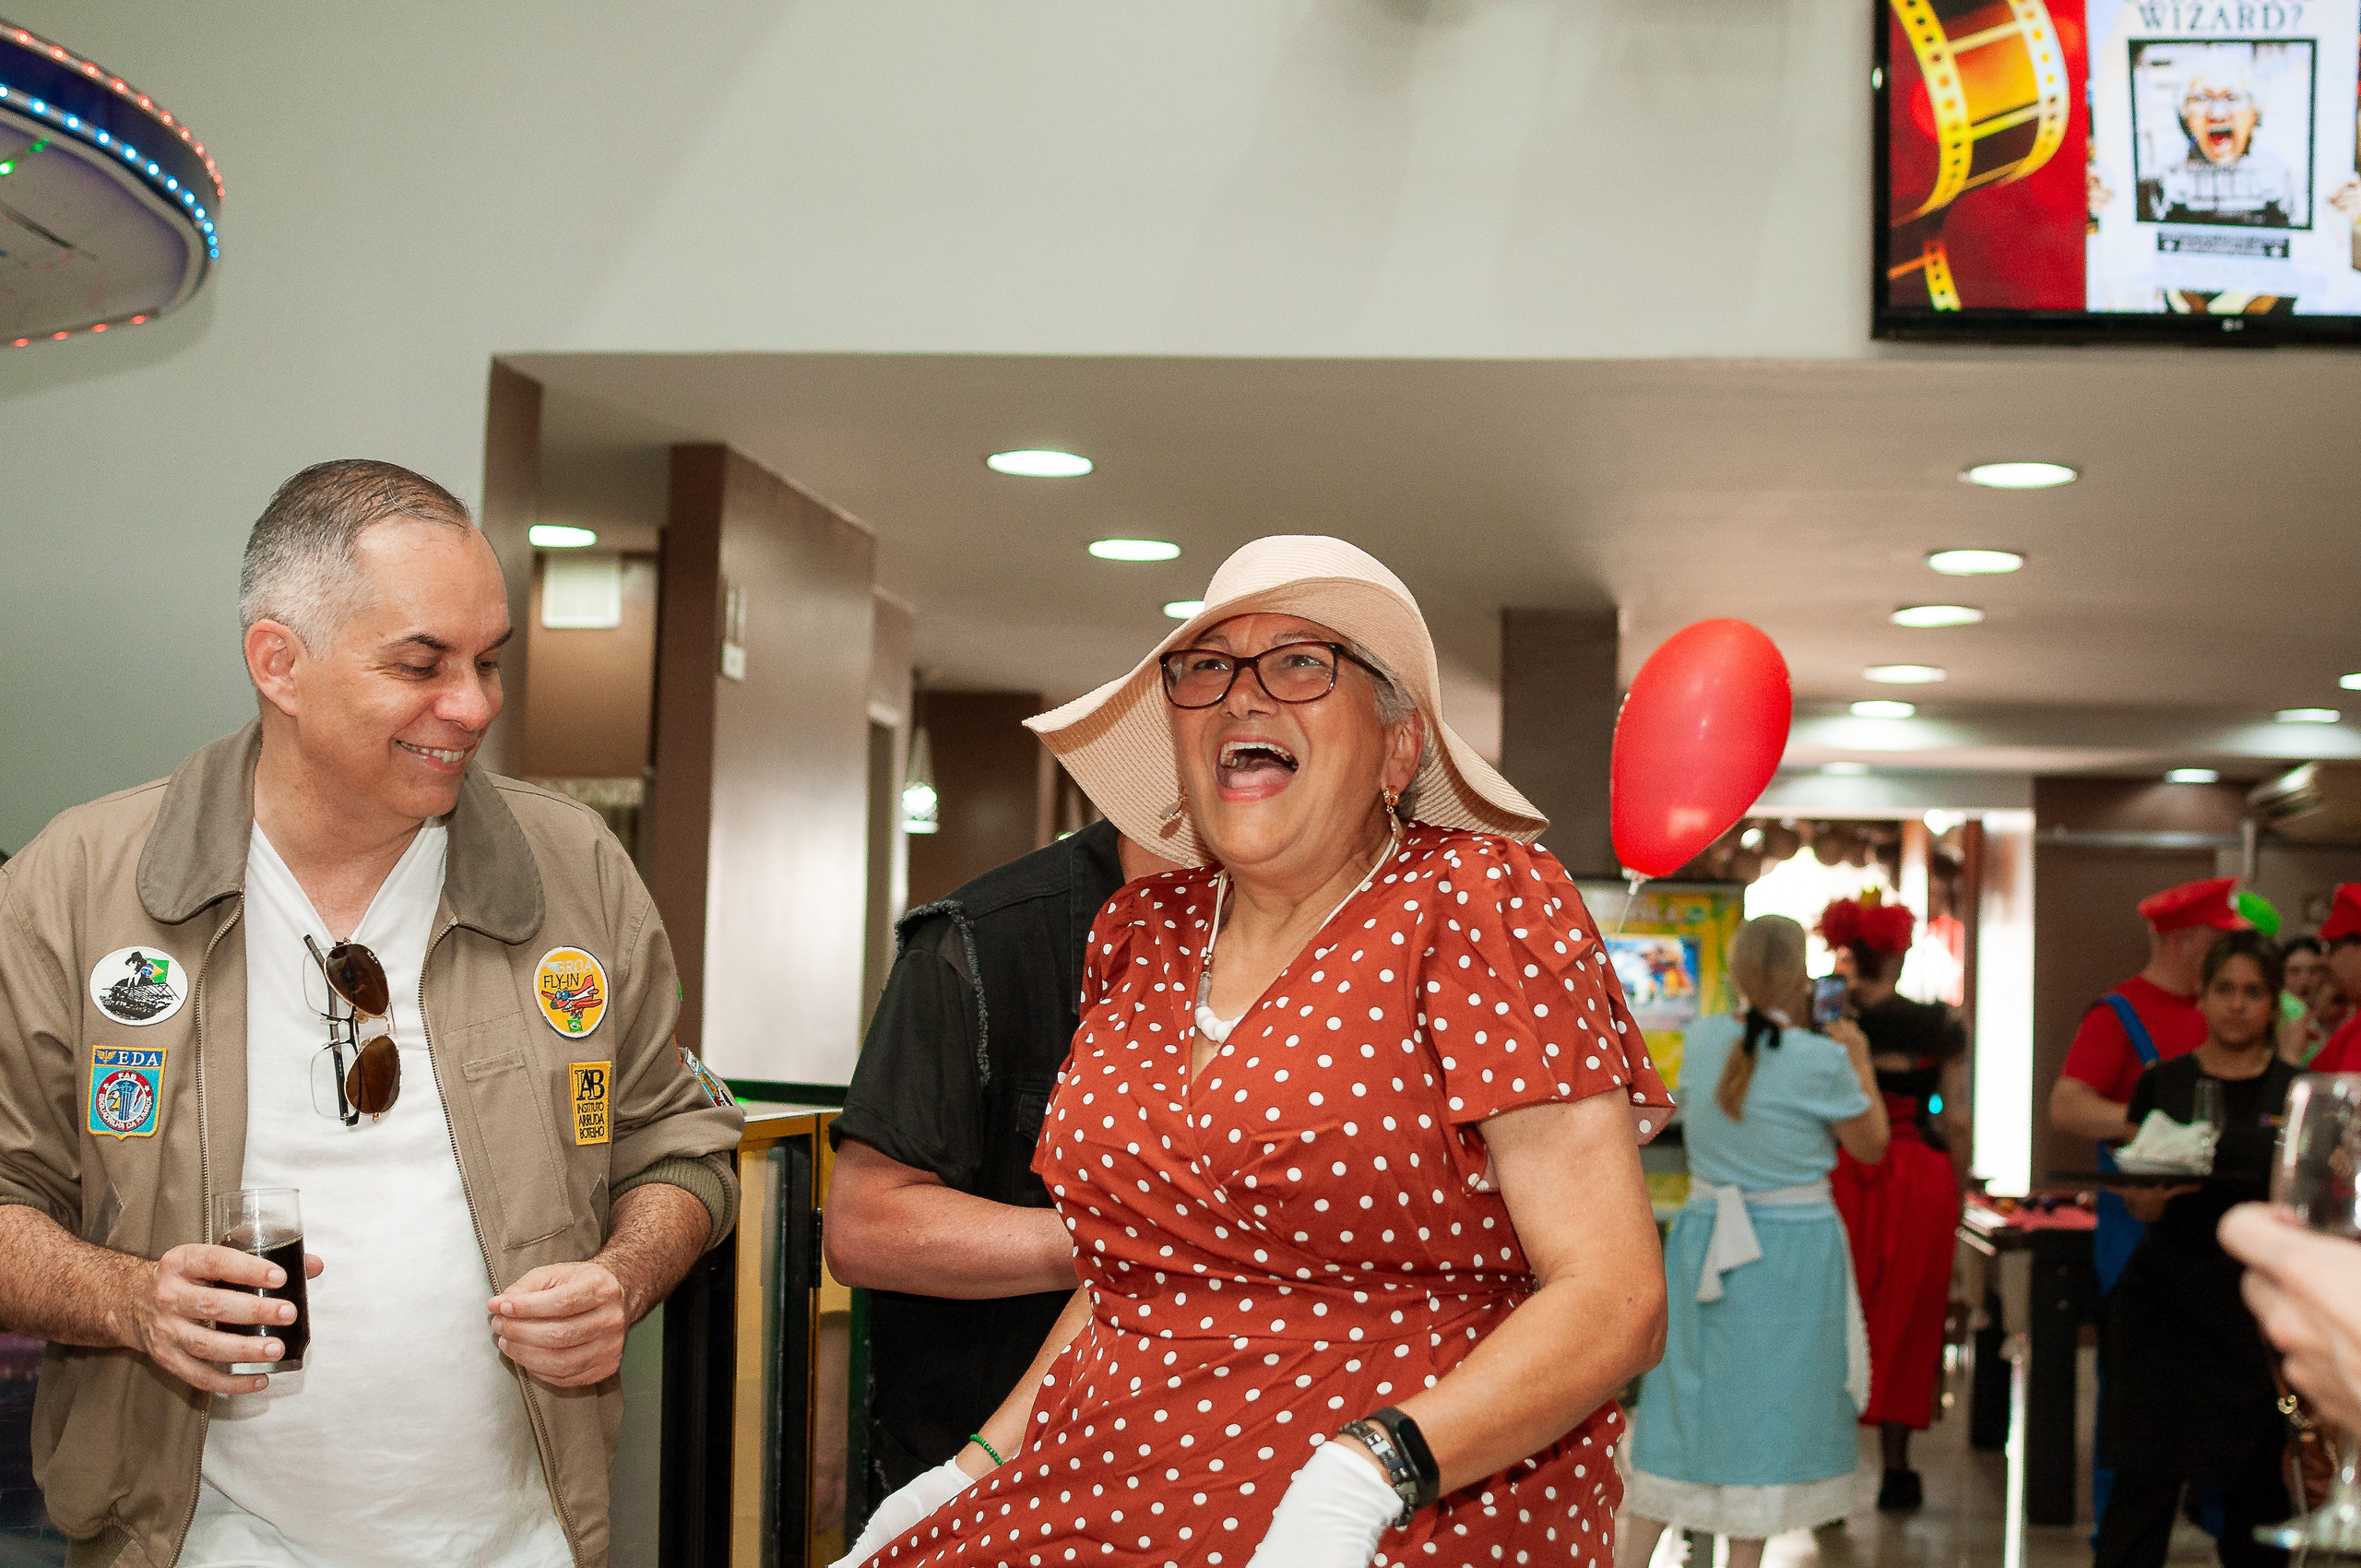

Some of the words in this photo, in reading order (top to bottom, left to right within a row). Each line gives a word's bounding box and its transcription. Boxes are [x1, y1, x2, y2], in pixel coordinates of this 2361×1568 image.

[2138, 4, 2304, 31] WIZARD?
[557, 959, 594, 975] BROA
[544, 973, 579, 989] FLY-IN
[117, 1051, 159, 1065] EDA
[575, 1069, 605, 1101] IAB
[577, 1101, 605, 1115] INSTITUTO
[578, 1112, 605, 1127] ARRUDA
[579, 1125, 605, 1140] BOTELHO
